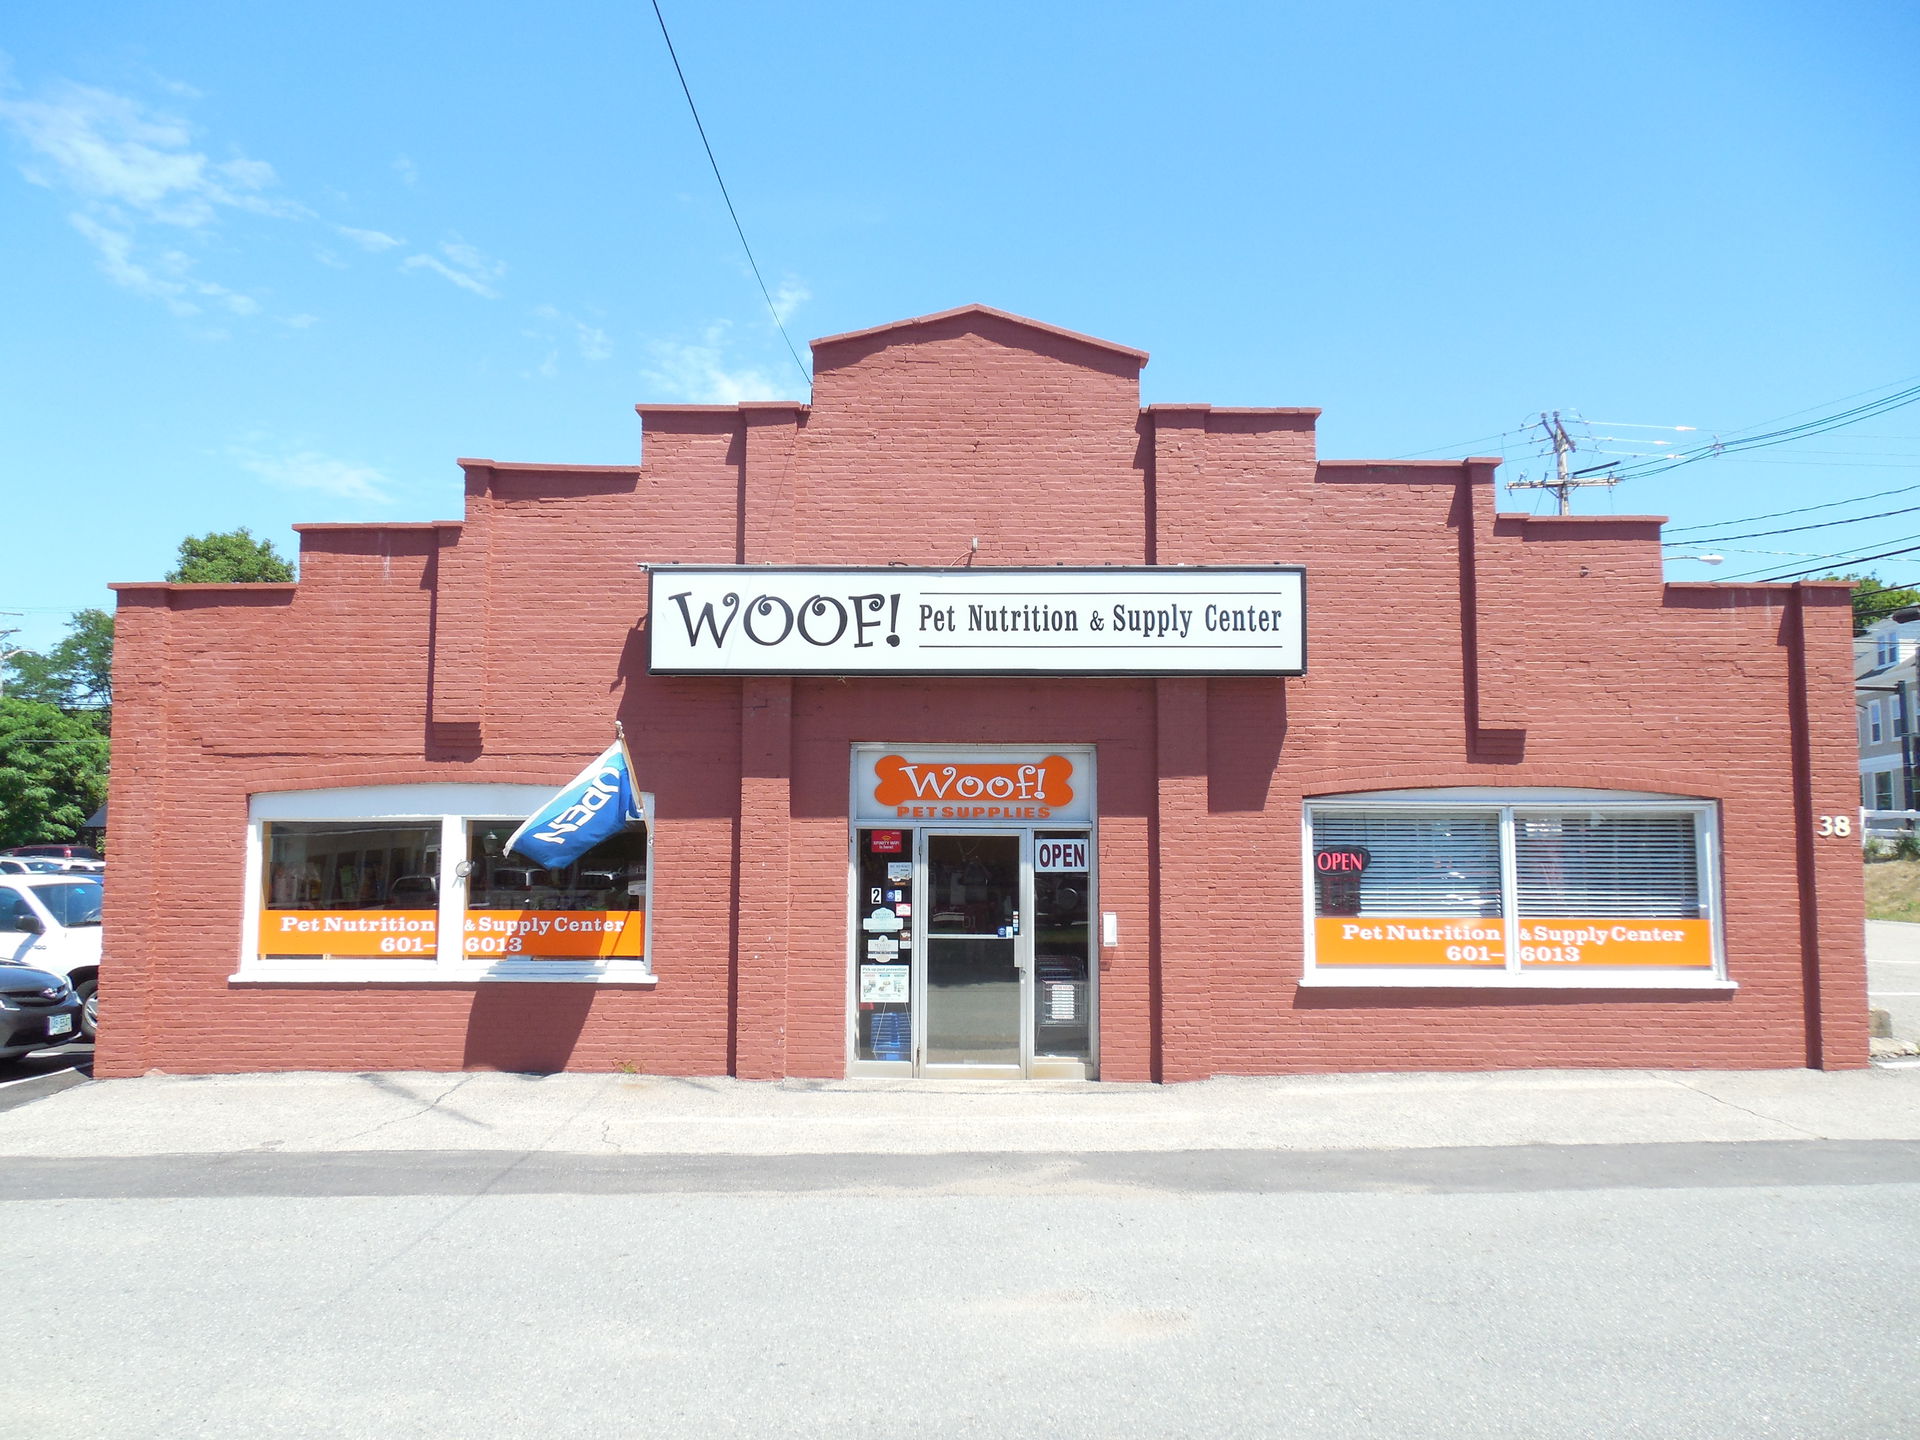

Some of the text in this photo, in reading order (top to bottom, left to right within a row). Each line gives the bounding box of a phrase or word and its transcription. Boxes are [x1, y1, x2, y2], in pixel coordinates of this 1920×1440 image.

[668, 591, 1282, 649] WOOF! Pet Nutrition & Supply Center
[898, 765, 1046, 799] Woof!
[897, 806, 1052, 819] PET SUPPLIES
[1816, 815, 1851, 838] 38
[1039, 843, 1085, 868] OPEN
[1317, 852, 1363, 871] OPEN
[873, 888, 880, 903] 2
[280, 916, 625, 936] Pet Nutrition & Supply Center
[1342, 924, 1684, 945] Pet Nutrition & Supply Center
[465, 936, 522, 952] 6013
[1520, 946, 1580, 962] 6013
